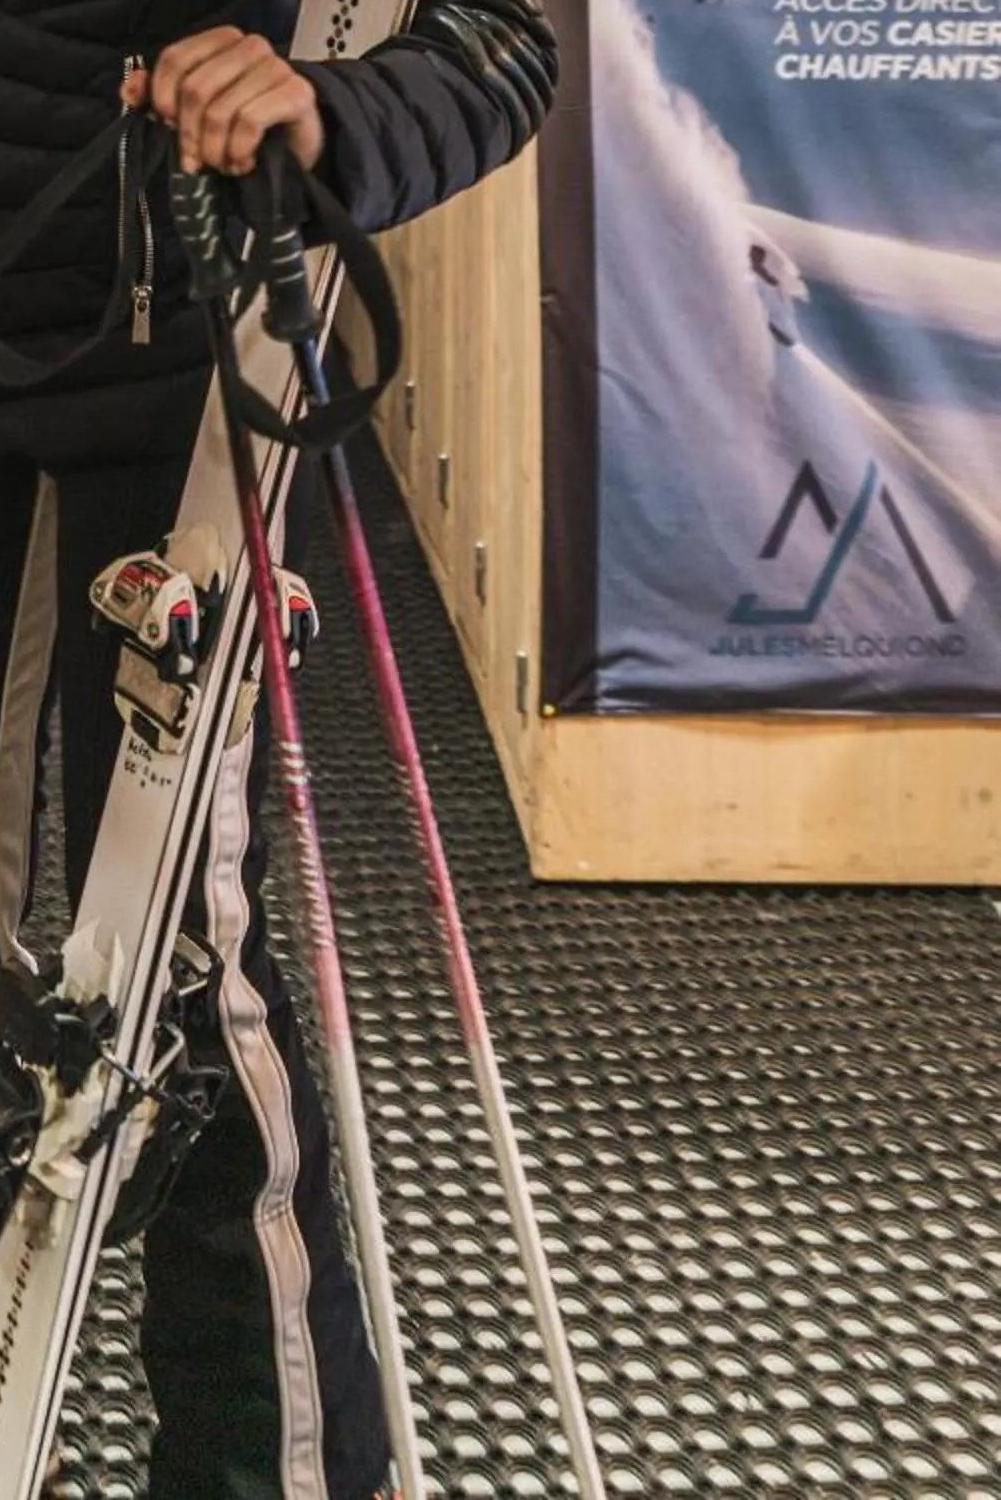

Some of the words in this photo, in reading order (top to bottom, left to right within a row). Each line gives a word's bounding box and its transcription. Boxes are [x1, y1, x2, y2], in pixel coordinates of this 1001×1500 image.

[774, 15, 799, 46] À
[810, 20, 879, 46] VOS
[775, 54, 1001, 80] CHAUFFANTS
